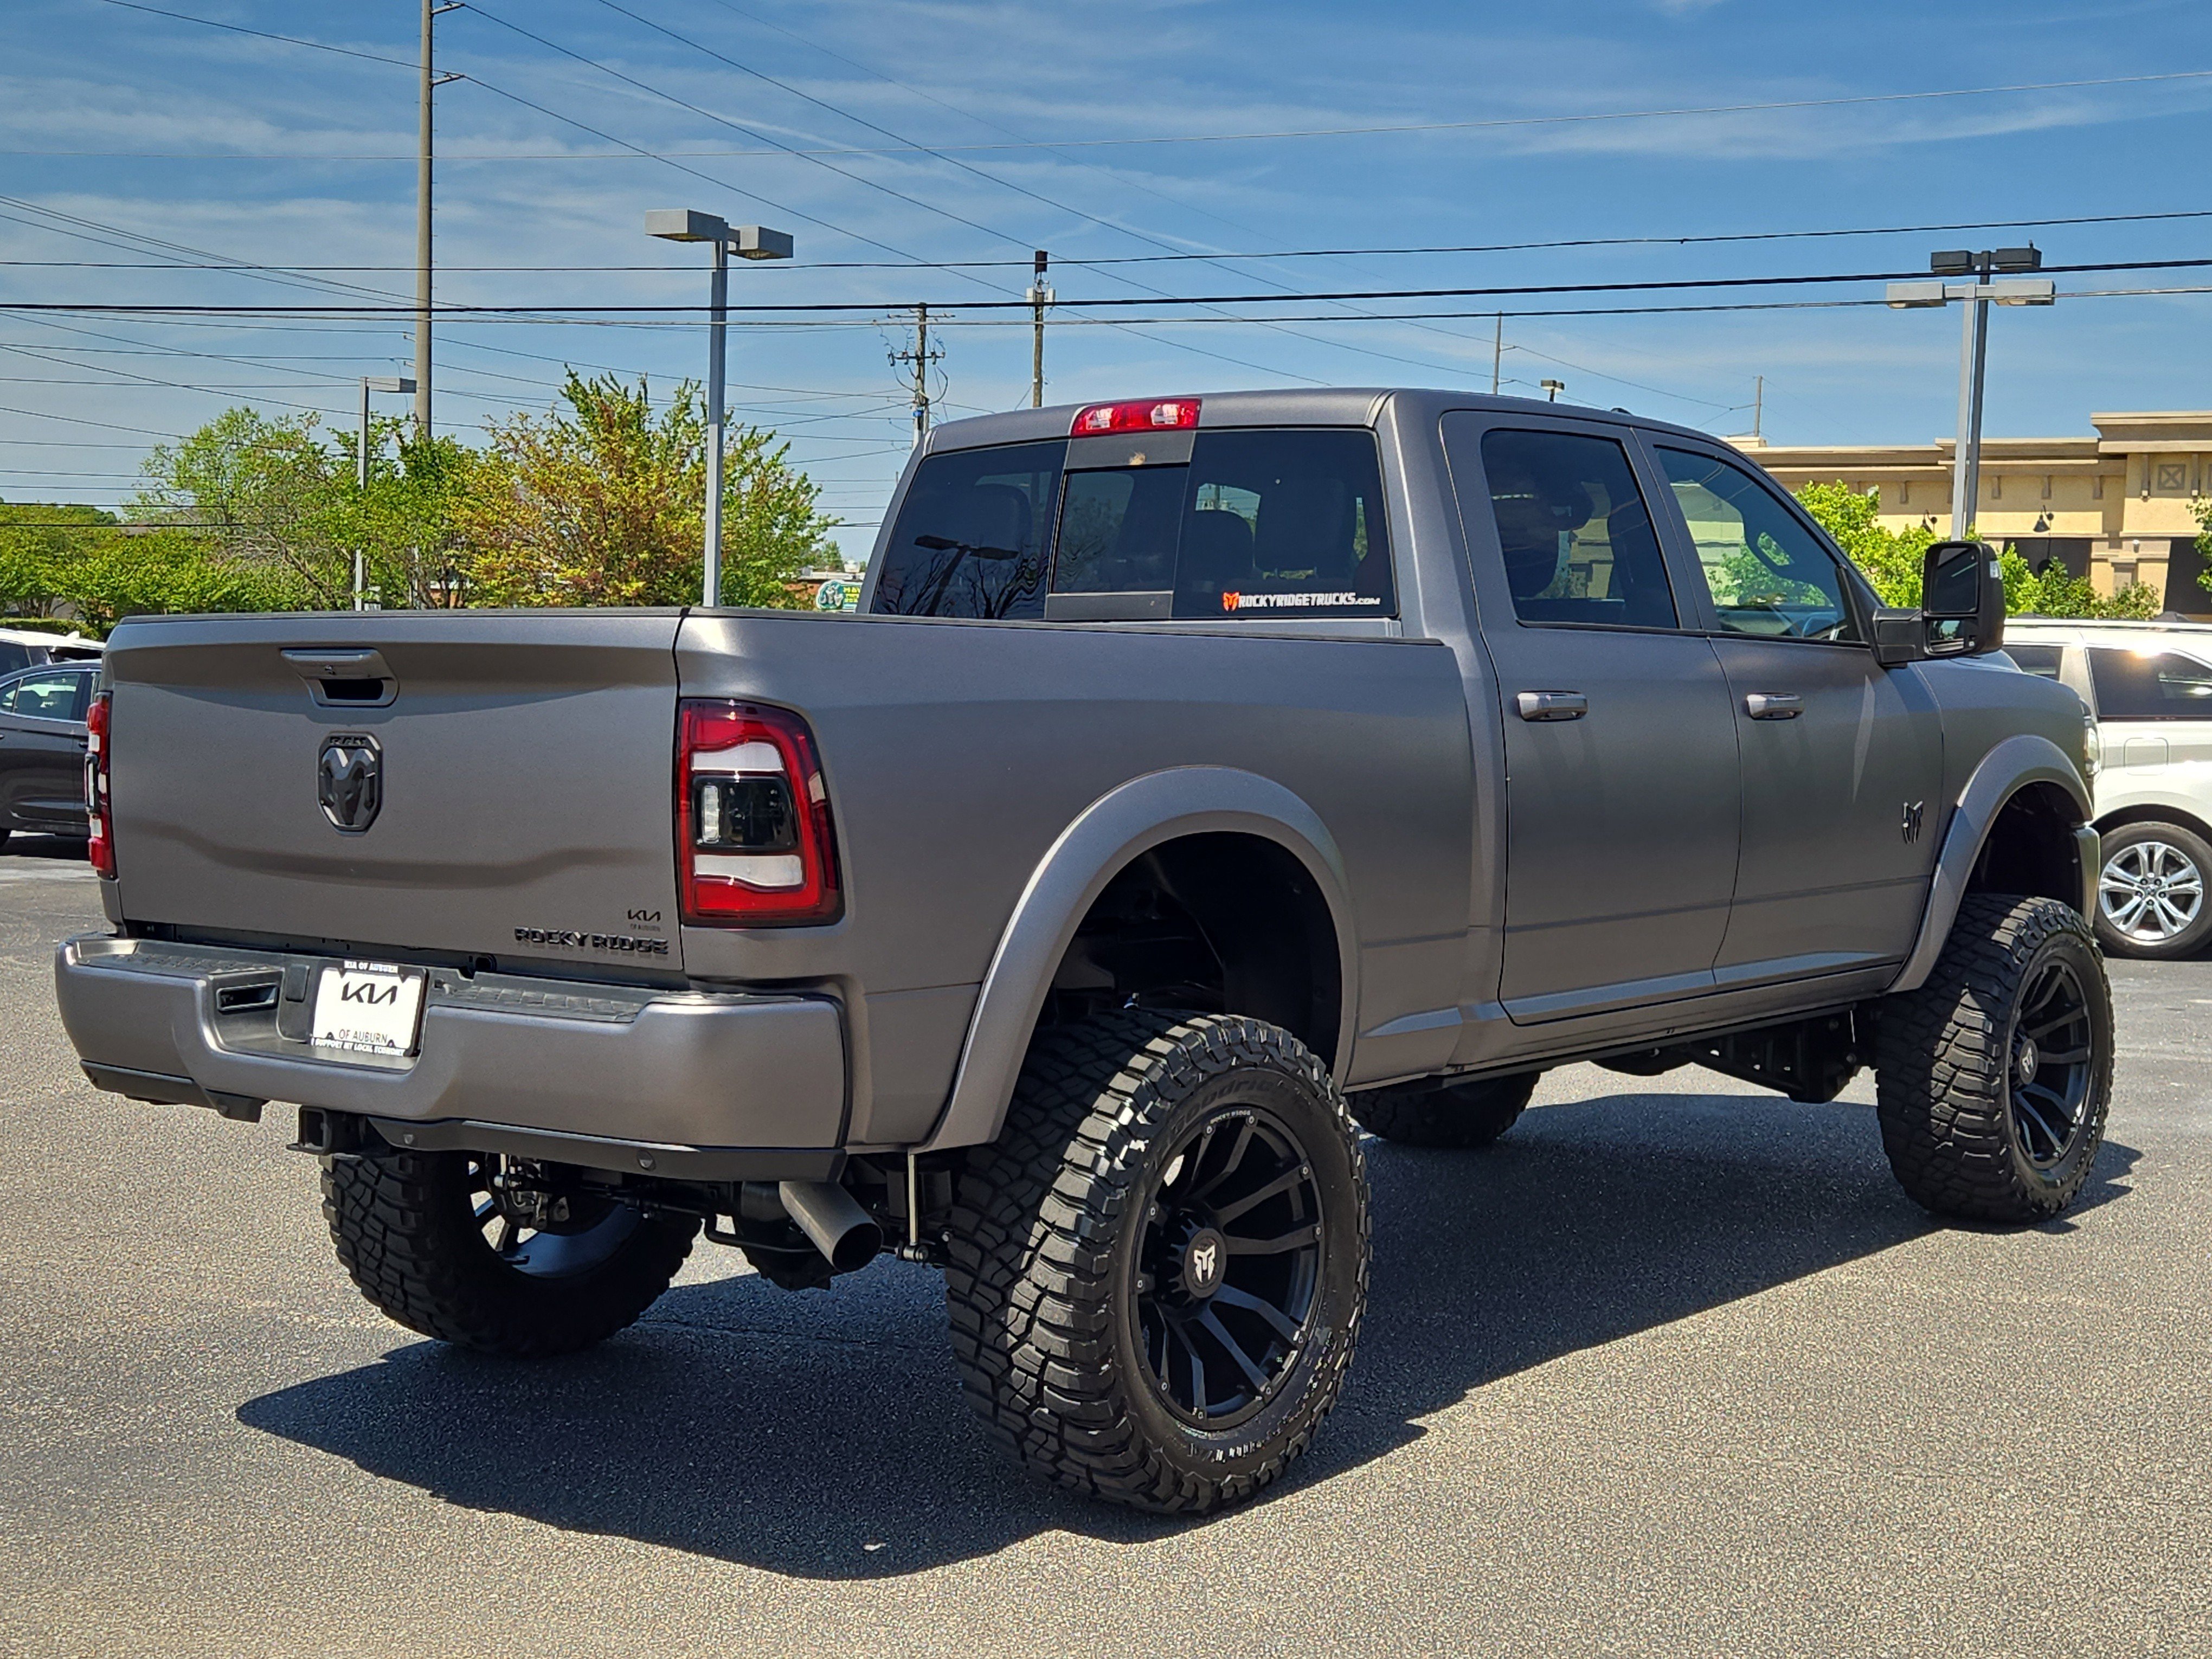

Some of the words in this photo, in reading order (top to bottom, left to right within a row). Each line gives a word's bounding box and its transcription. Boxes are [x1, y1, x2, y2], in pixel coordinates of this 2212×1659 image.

[330, 736, 366, 745] RAM
[627, 909, 661, 922] KIA
[515, 926, 589, 947] ROCKY
[591, 933, 668, 955] RIDGE
[341, 981, 397, 1005] KIA
[339, 1029, 350, 1040] OF
[352, 1031, 388, 1044] AUBURN
